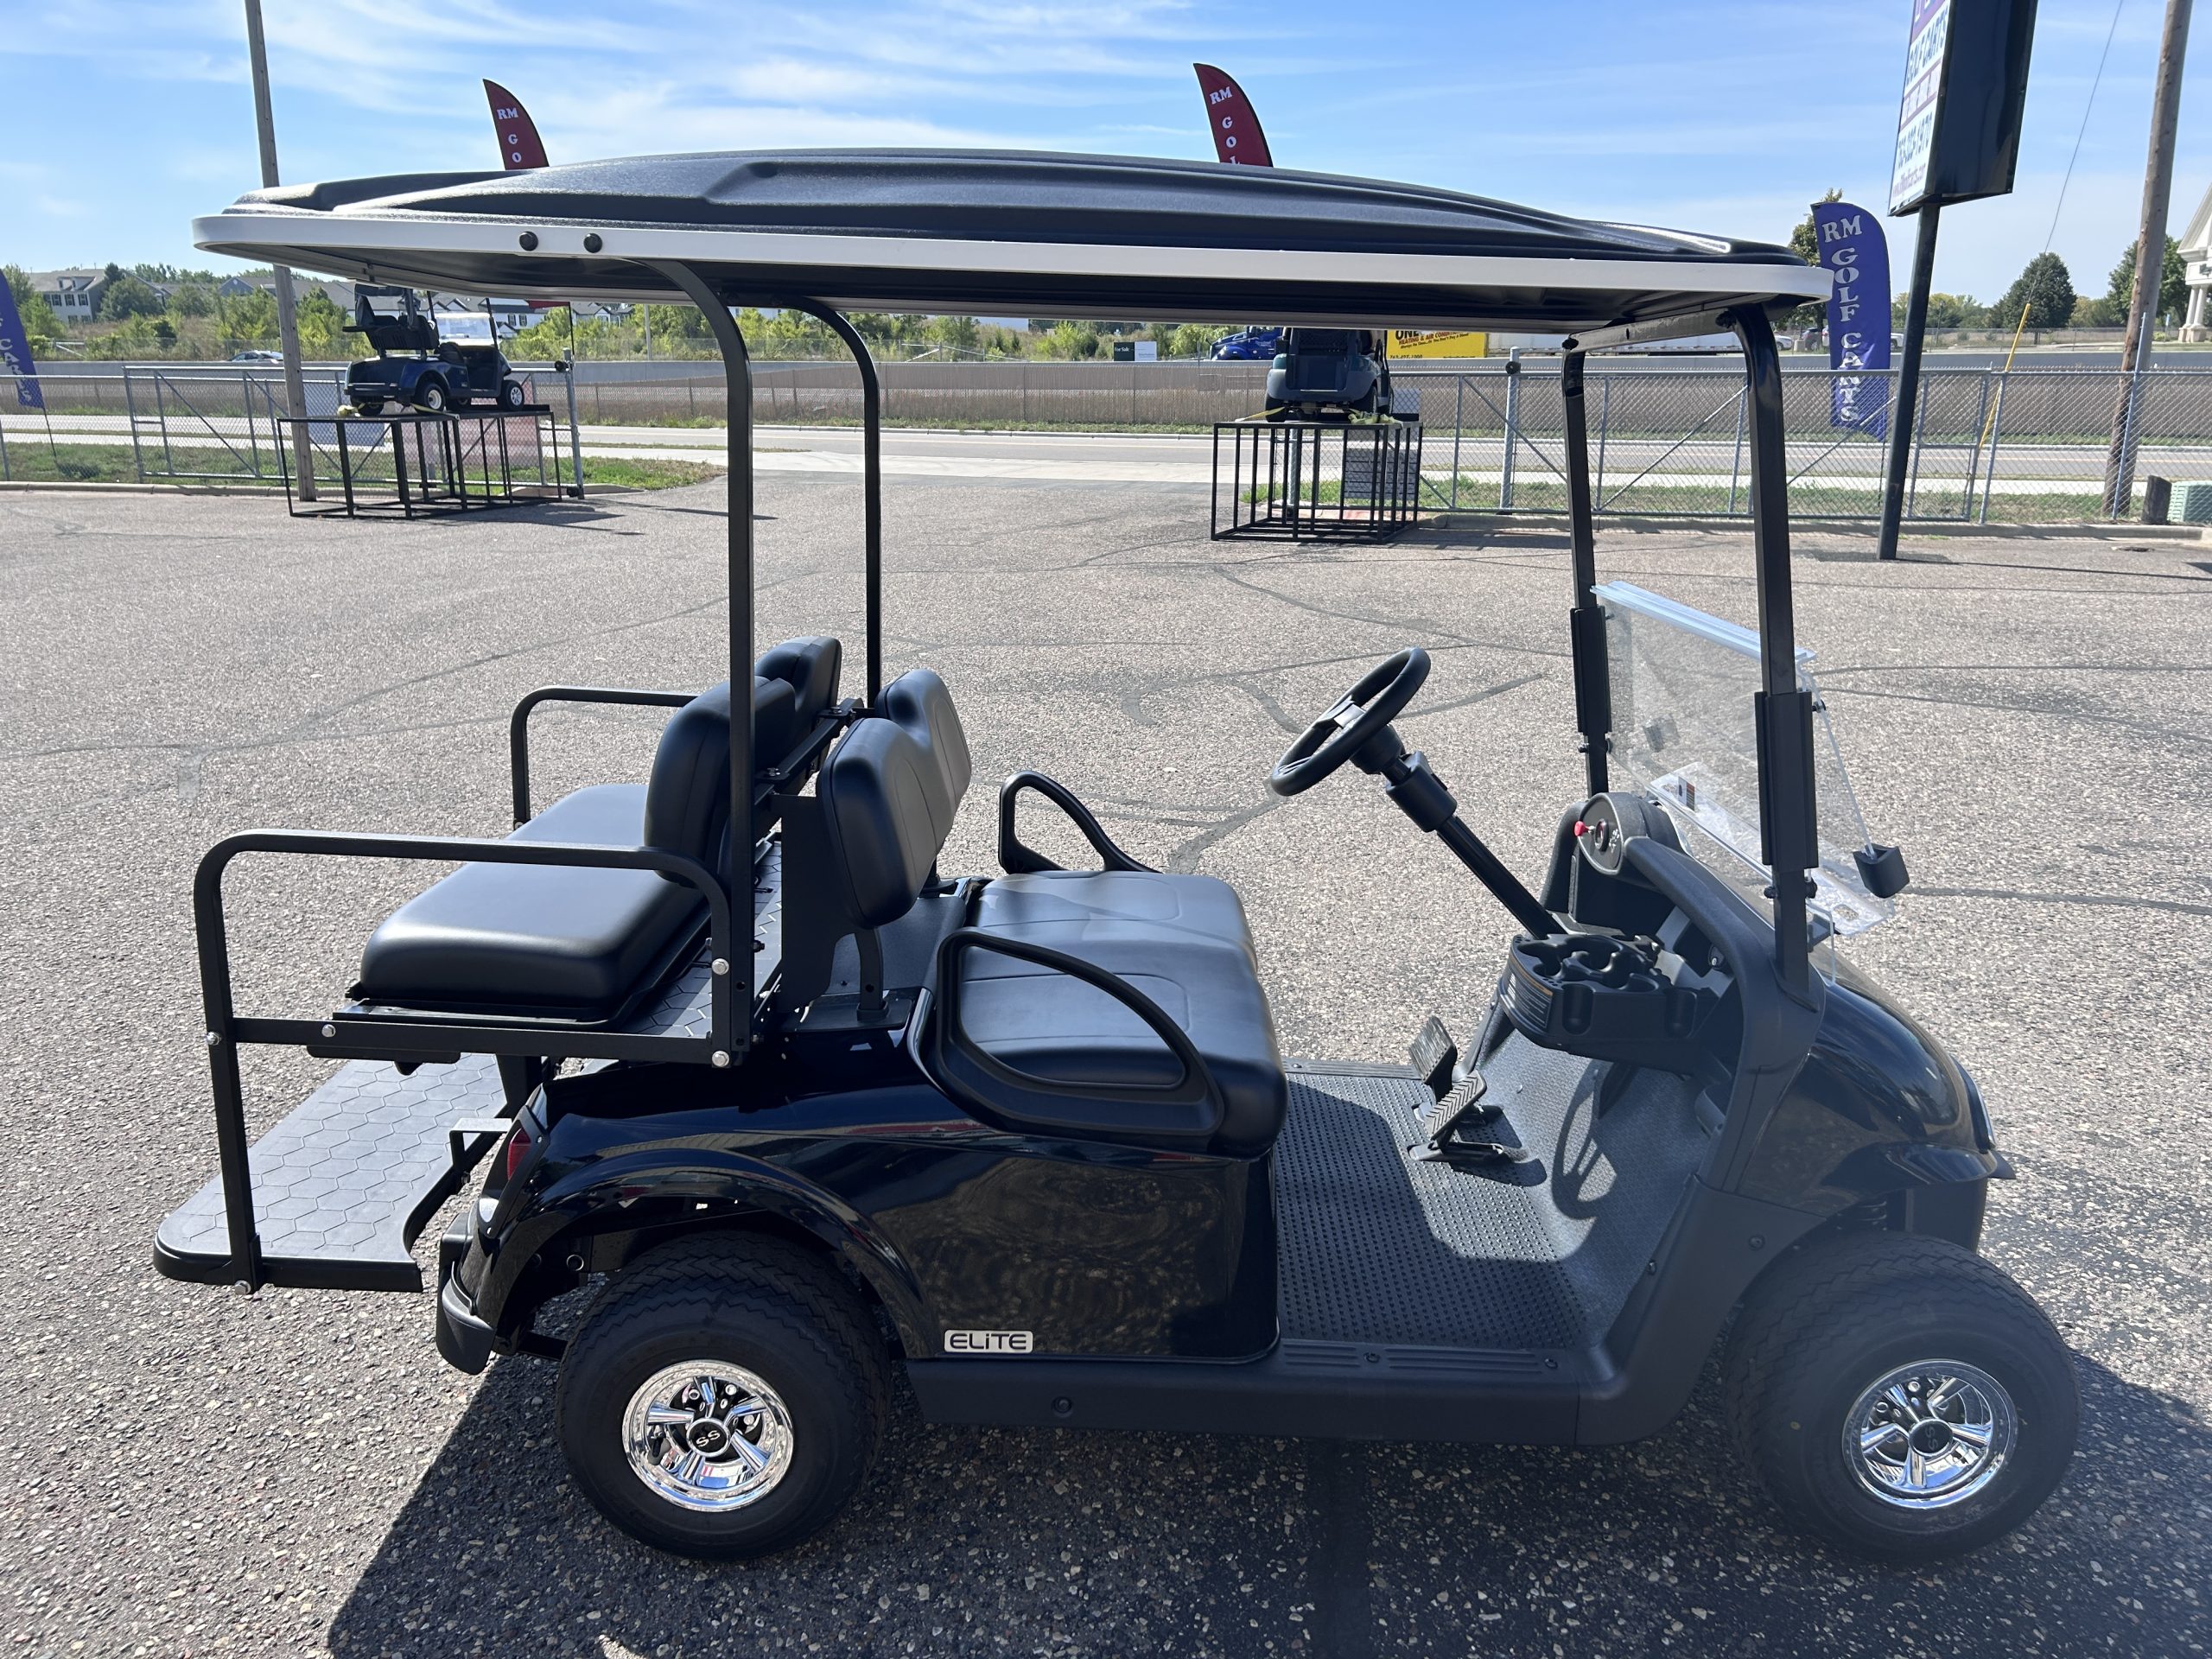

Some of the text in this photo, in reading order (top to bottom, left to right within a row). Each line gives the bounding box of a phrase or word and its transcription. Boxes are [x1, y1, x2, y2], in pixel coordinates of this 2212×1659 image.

[1210, 86, 1232, 105] RM
[497, 108, 518, 119] RM
[508, 134, 521, 162] GO
[1222, 117, 1240, 164] GOL
[1821, 214, 1863, 244] RM
[1831, 247, 1860, 323] GOLF
[1839, 332, 1864, 423] CARTS
[696, 1430, 720, 1446] SS
